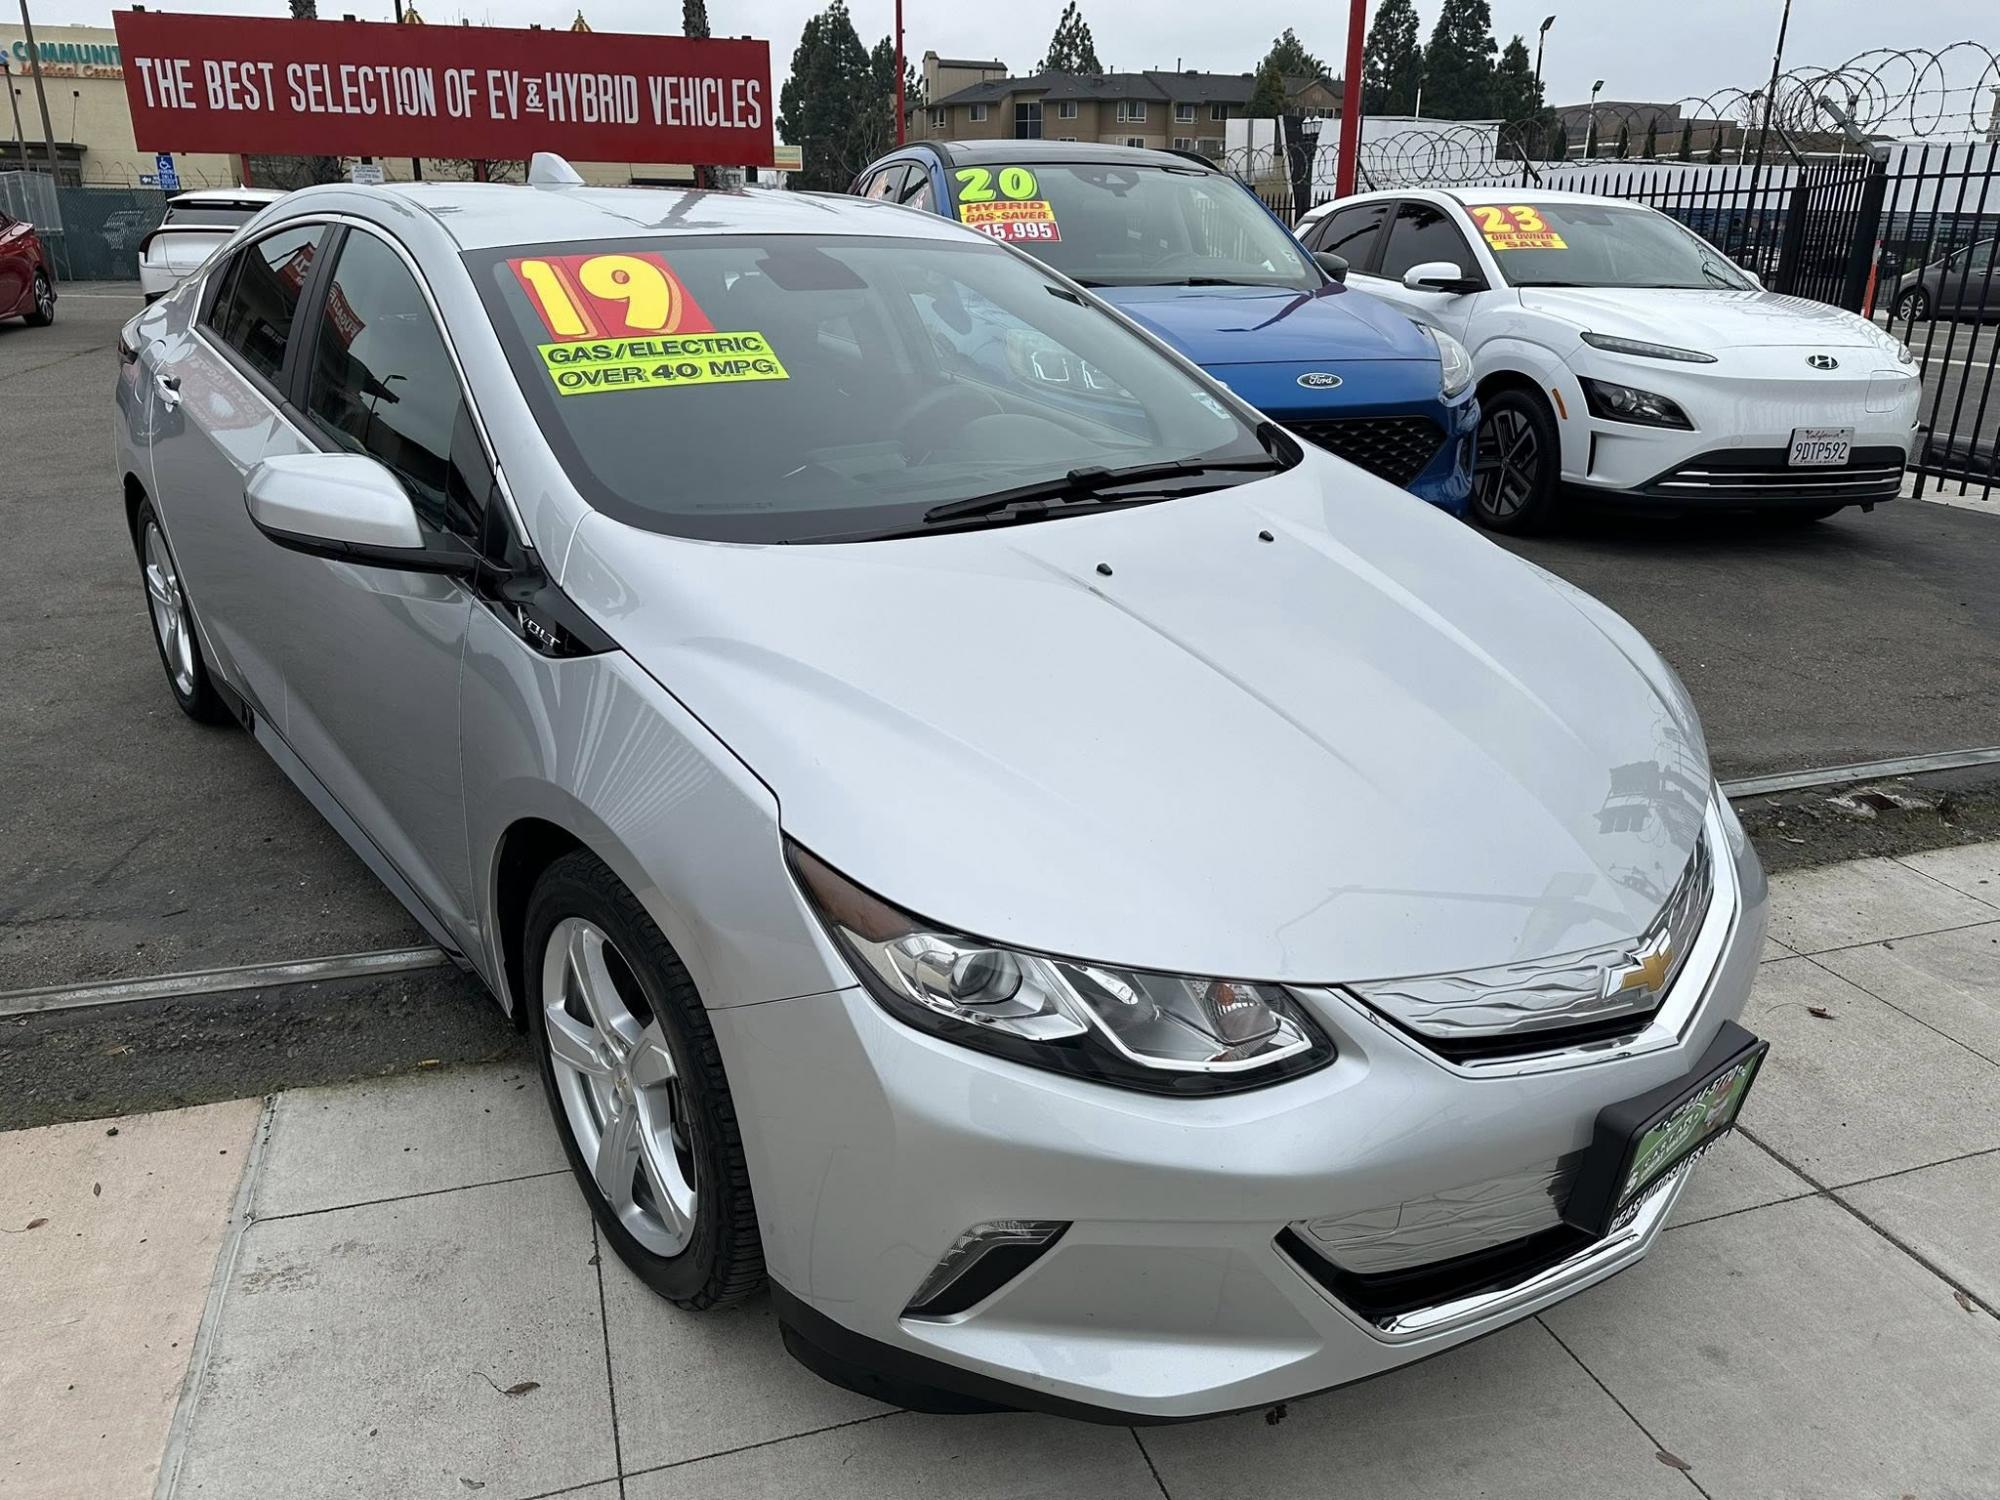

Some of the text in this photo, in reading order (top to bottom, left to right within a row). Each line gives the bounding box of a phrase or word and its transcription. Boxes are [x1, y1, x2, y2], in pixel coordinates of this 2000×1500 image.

[135, 57, 761, 129] THE BEST SELECTION OF EV & HYBRID VEHICLES
[955, 167, 1037, 201] 20
[966, 202, 1045, 213] HYBRID
[966, 211, 1049, 223] GAS-SAVER
[1472, 205, 1546, 231] 23
[1505, 240, 1553, 248] SALE
[1516, 232, 1553, 240] OWNER
[521, 255, 677, 336] 19
[548, 337, 762, 364] GAS/ELECTRIC
[558, 358, 776, 389] OVER 40 MPG
[1308, 374, 1334, 385] Ford
[1793, 441, 1848, 460] 9DTP592
[517, 605, 561, 647] VOLT
